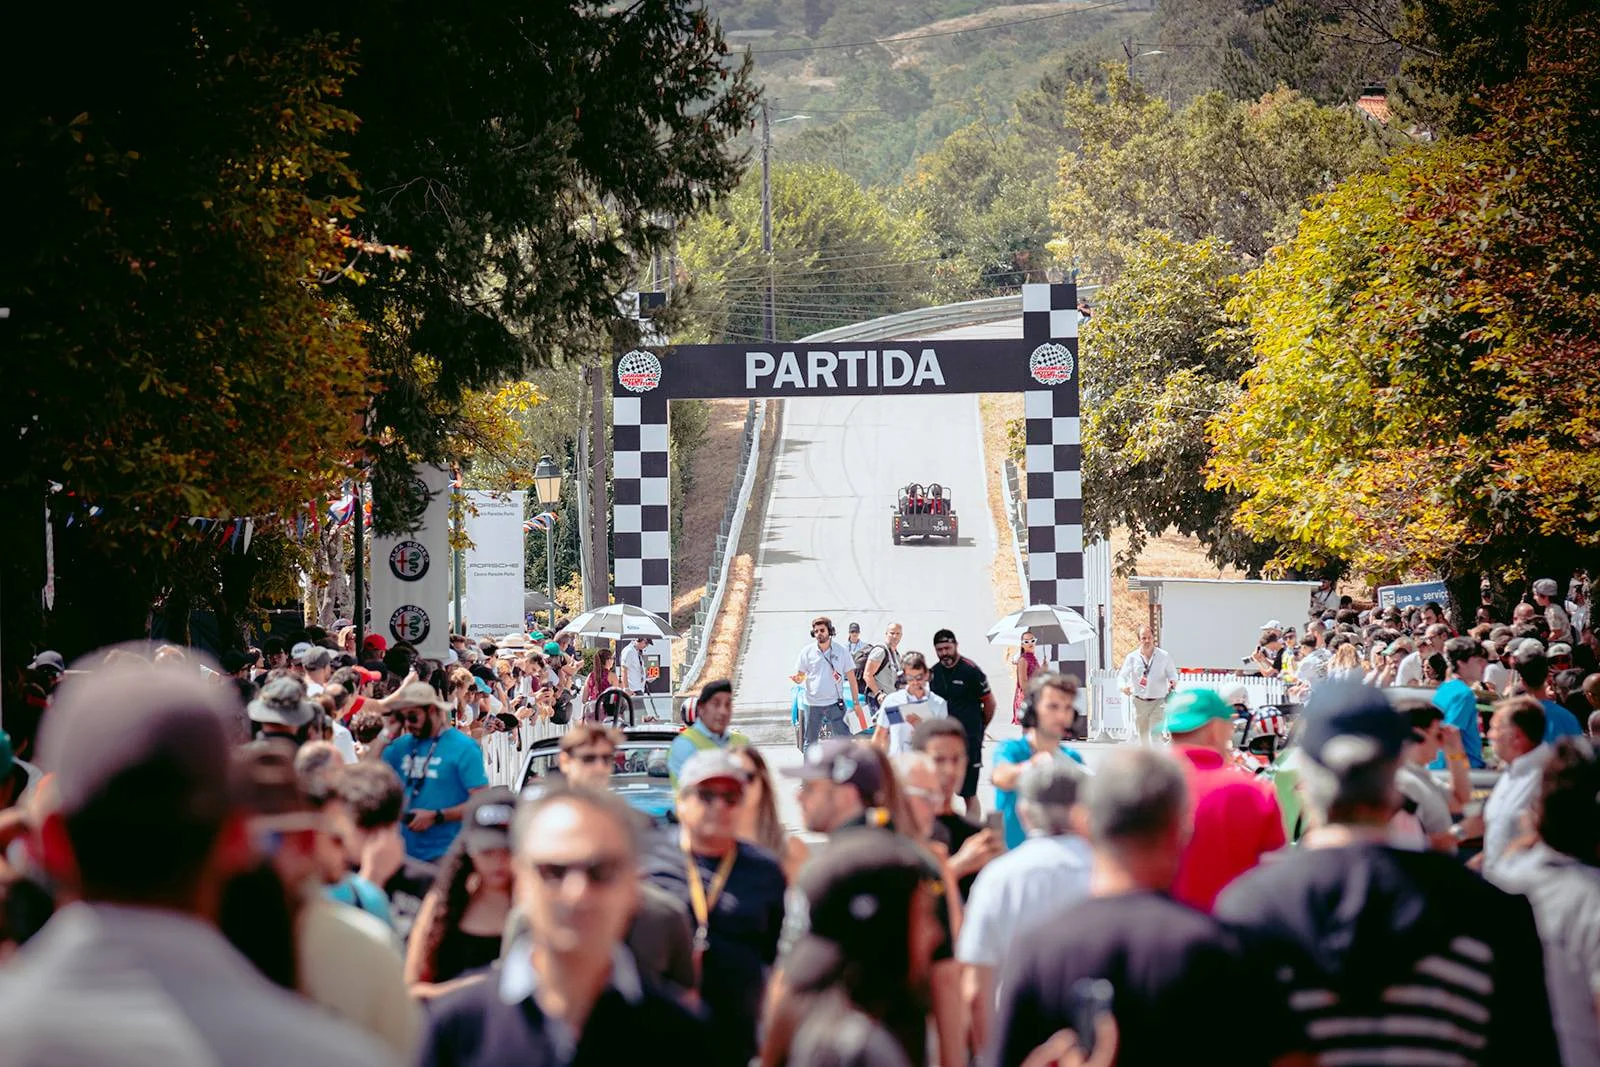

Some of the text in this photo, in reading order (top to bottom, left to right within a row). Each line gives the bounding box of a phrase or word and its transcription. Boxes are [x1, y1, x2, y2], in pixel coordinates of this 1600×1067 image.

[745, 349, 946, 389] PARTIDA
[406, 541, 429, 563] ROMEO
[1396, 593, 1412, 603] área
[406, 605, 429, 627] ROMEO
